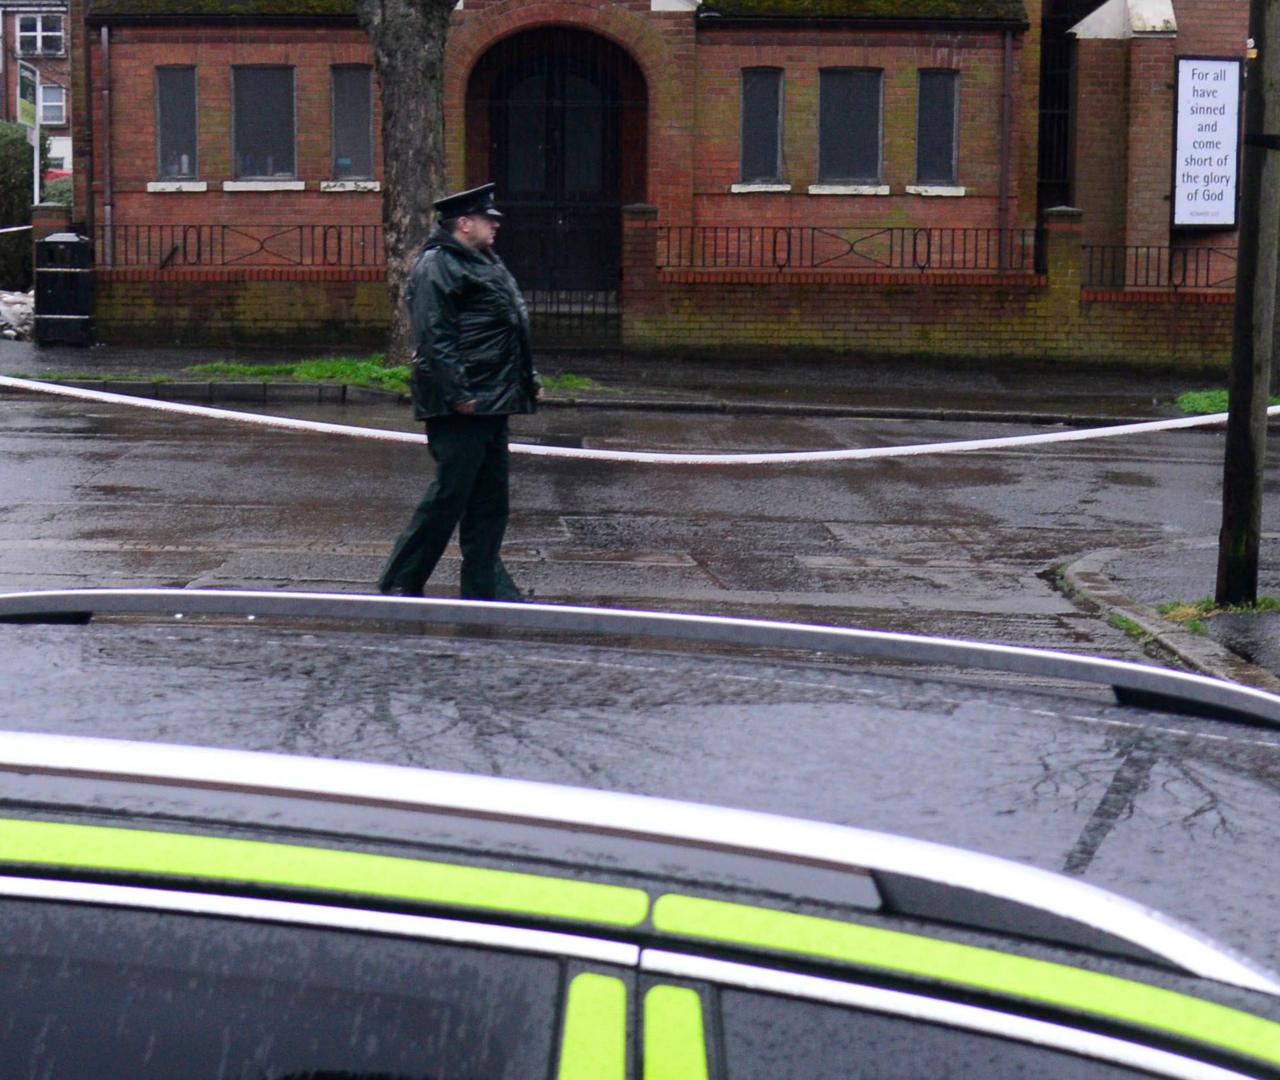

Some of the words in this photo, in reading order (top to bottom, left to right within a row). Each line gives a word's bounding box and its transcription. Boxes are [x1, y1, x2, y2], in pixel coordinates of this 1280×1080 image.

[1191, 67, 1209, 81] For
[1212, 68, 1227, 81] all
[1192, 84, 1219, 98] have
[1189, 102, 1226, 116] sinned
[1197, 120, 1218, 133] and
[1192, 140, 1222, 150] come
[1184, 154, 1213, 167] short
[1216, 154, 1230, 167] of
[1181, 171, 1200, 184] the
[1203, 171, 1231, 187] glory
[1186, 188, 1200, 201] of
[1202, 188, 1224, 201] God
